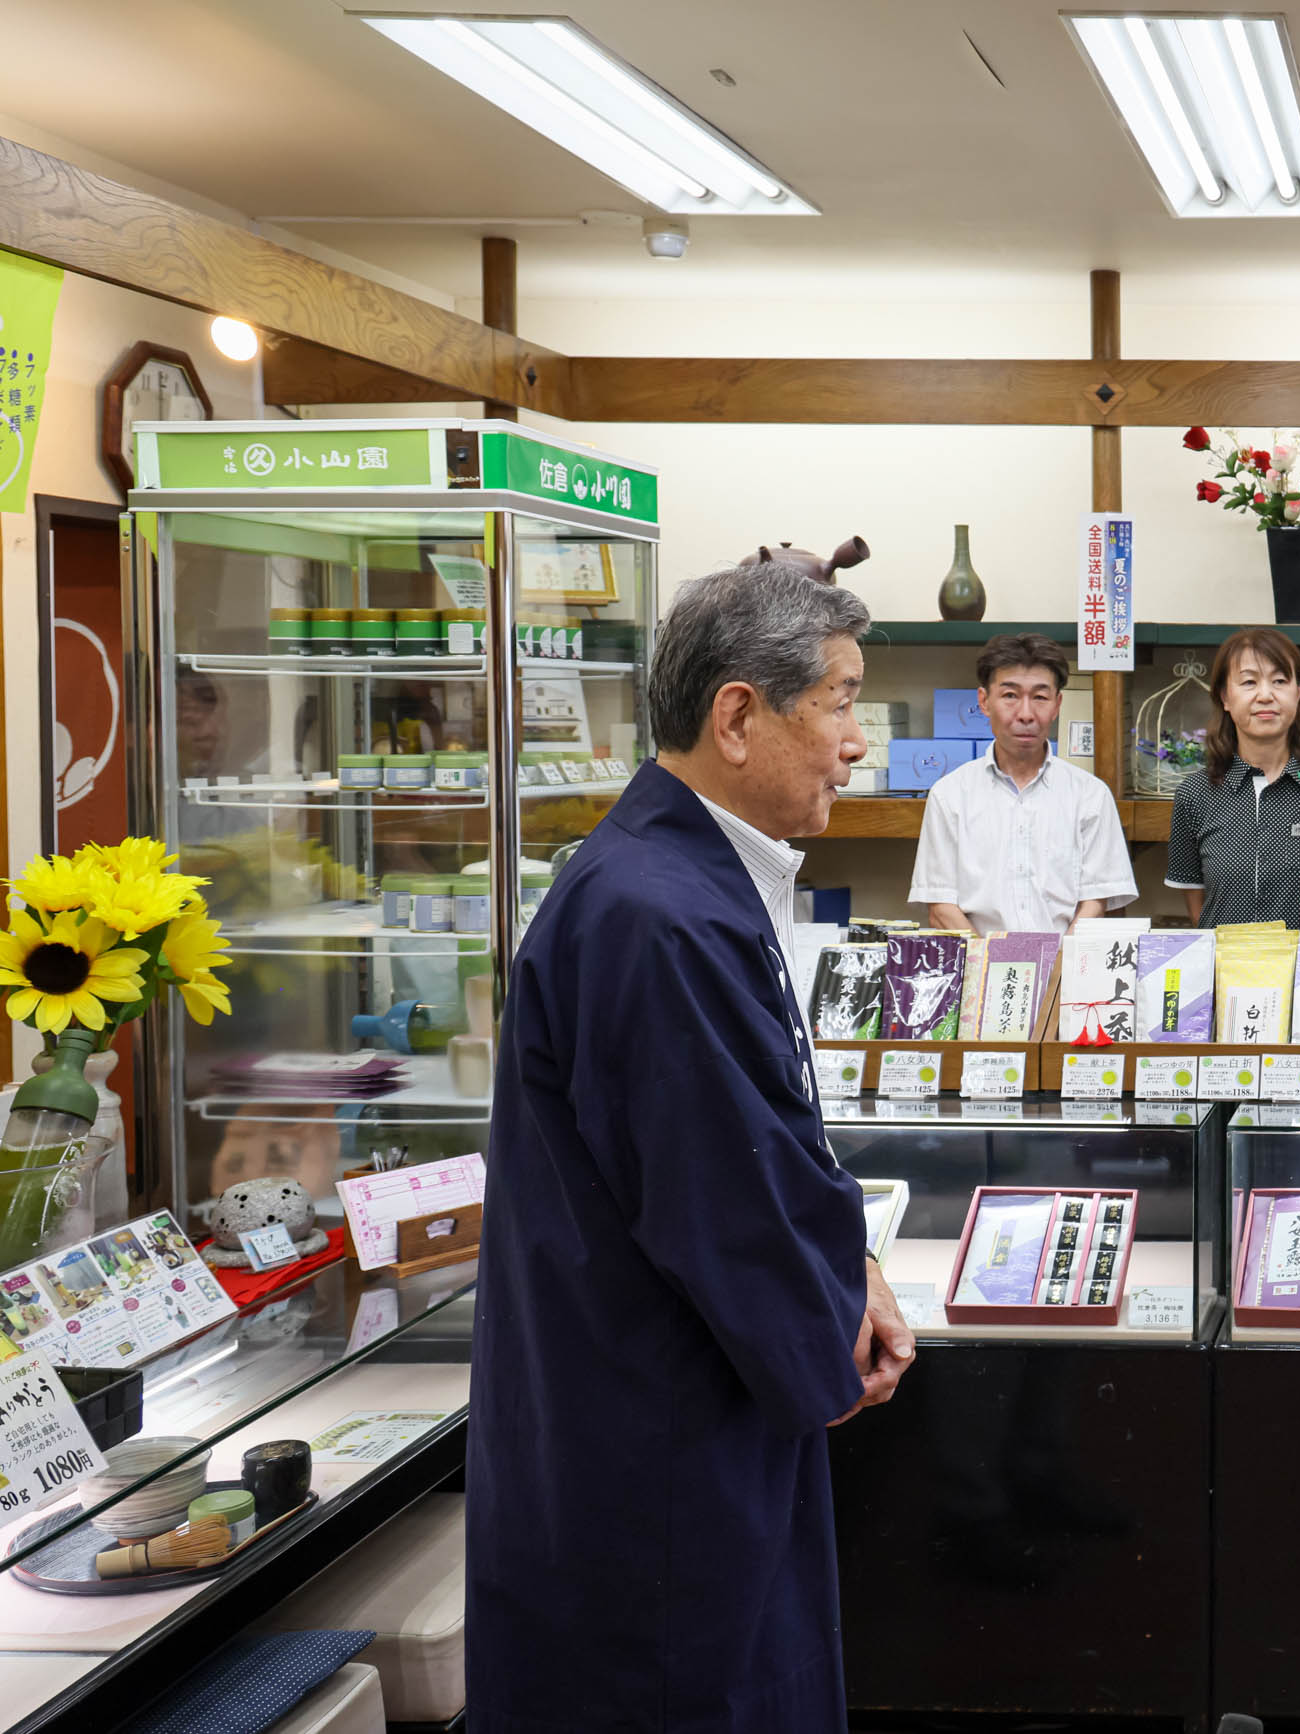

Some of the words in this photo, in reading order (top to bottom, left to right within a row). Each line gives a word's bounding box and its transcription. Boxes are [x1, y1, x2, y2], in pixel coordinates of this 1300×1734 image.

[24, 364, 36, 422] フッ素
[283, 446, 389, 470] 小山園
[538, 457, 569, 493] 佐倉
[590, 471, 633, 510] 小川園
[1083, 523, 1107, 647] 全国送料半額
[1112, 557, 1129, 634] 夏のご挨拶
[1103, 940, 1138, 1042] 献上茶
[1164, 991, 1179, 1032] つゆの芽
[1242, 1004, 1261, 1043] 白折
